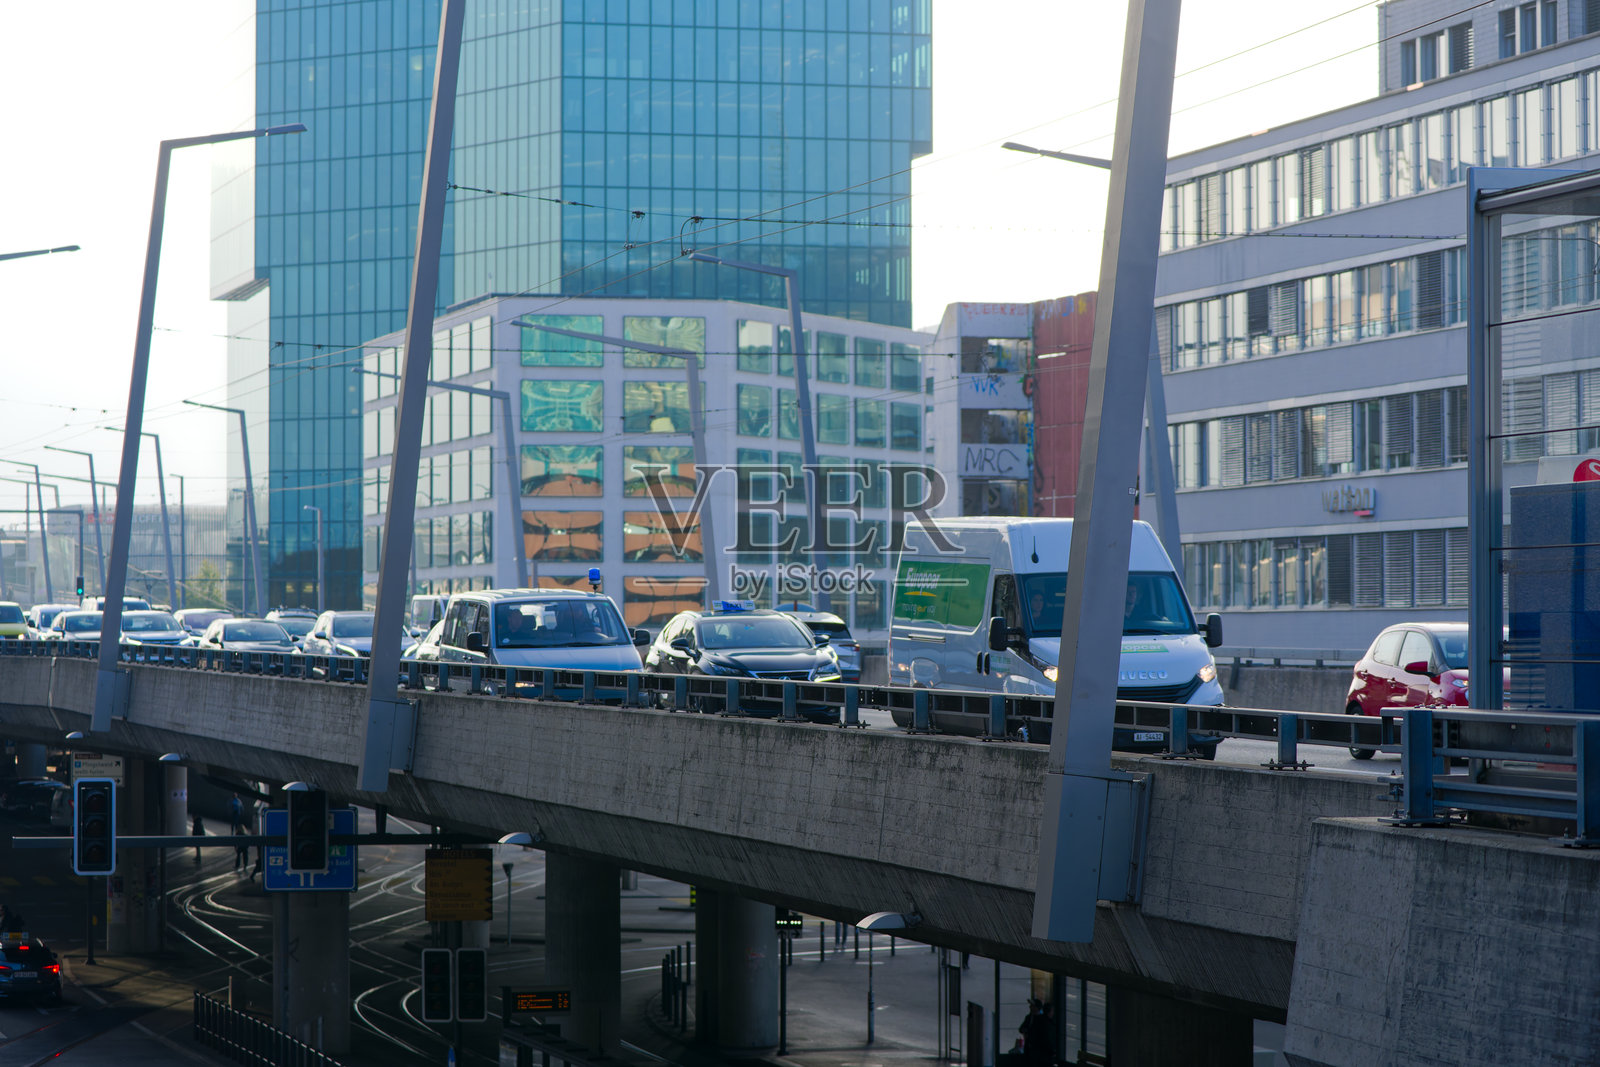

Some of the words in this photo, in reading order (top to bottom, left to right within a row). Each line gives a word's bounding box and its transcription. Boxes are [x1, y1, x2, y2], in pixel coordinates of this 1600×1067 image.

[965, 446, 1020, 474] MRC
[1321, 485, 1374, 512] watson
[904, 567, 941, 592] Europcar
[1120, 669, 1168, 681] IVECO
